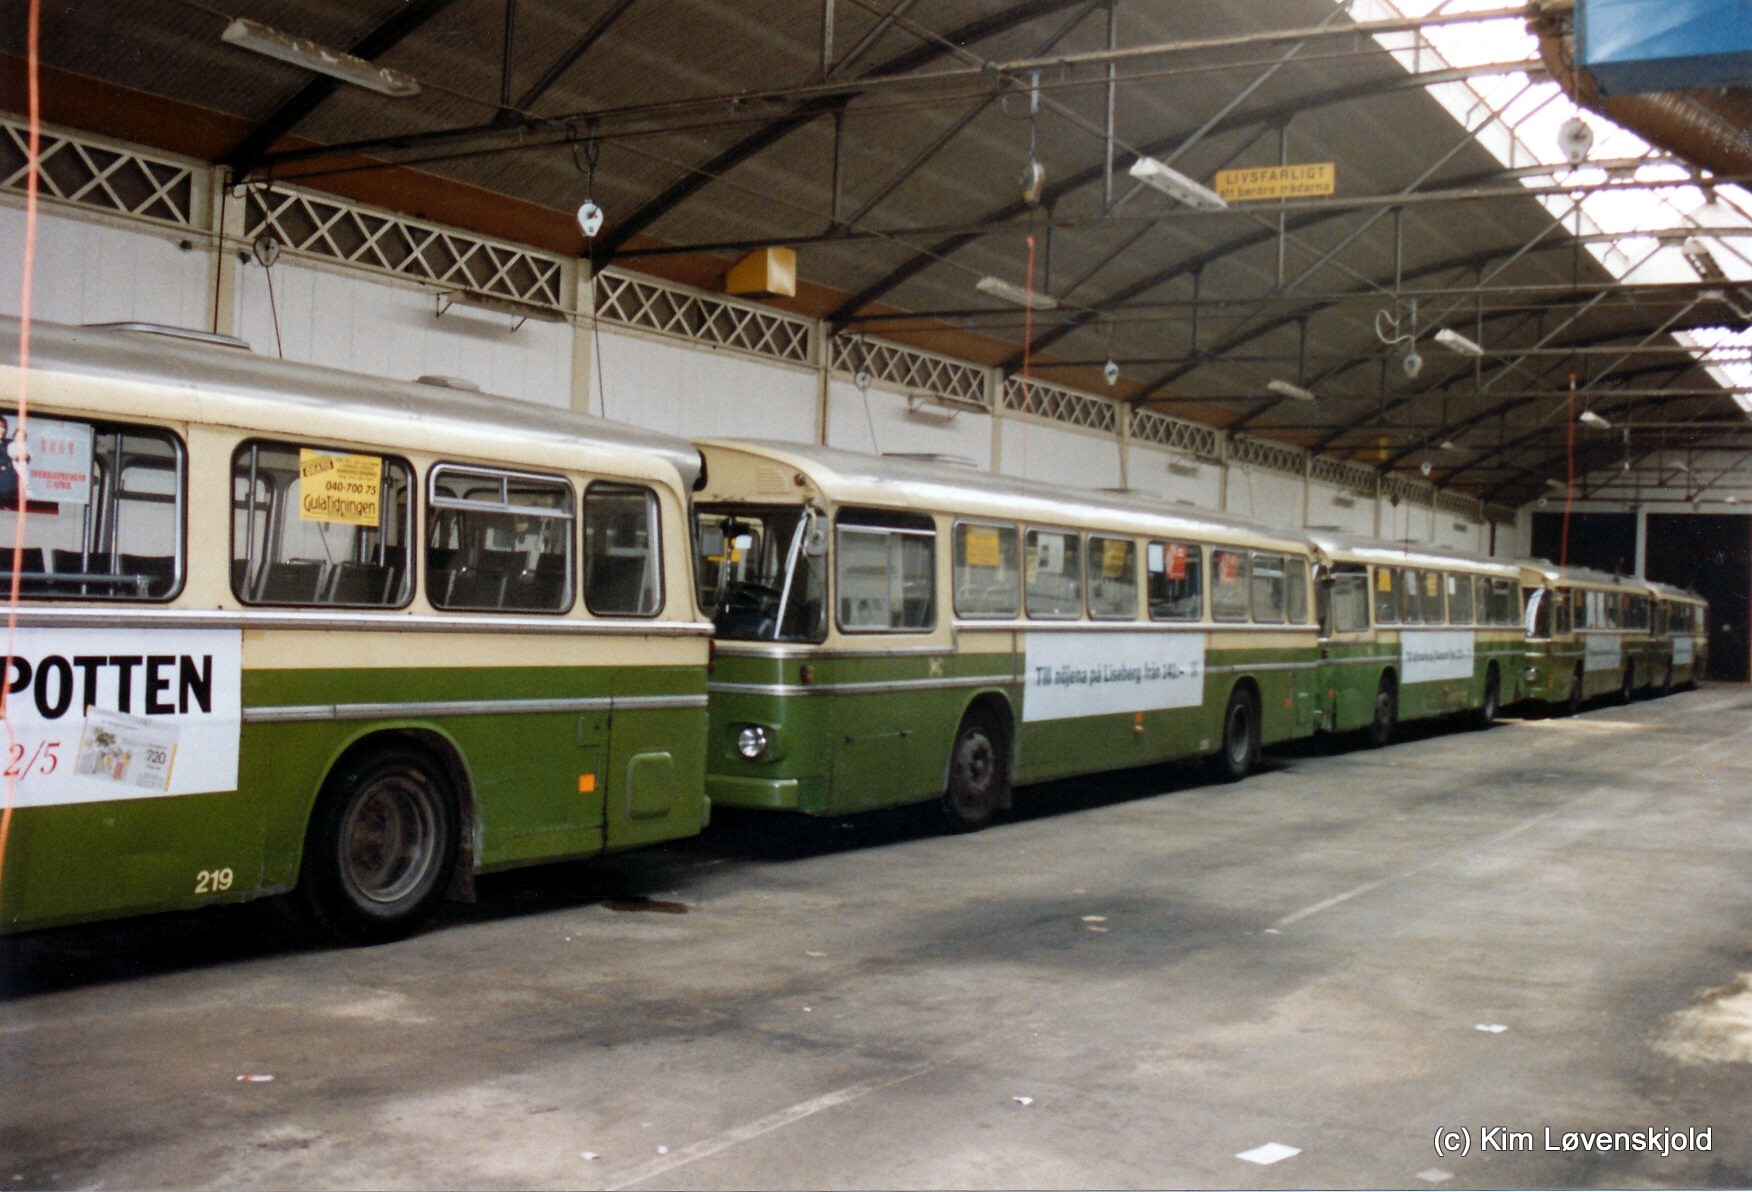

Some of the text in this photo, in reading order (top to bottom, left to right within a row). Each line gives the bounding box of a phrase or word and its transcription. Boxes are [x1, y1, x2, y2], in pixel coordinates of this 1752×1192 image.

[1226, 166, 1325, 184] LIVSFARLIGT
[325, 481, 376, 496] 040-700 75
[0, 655, 212, 720] POTTEN
[4, 740, 60, 781] 2/5
[195, 867, 233, 894] 219
